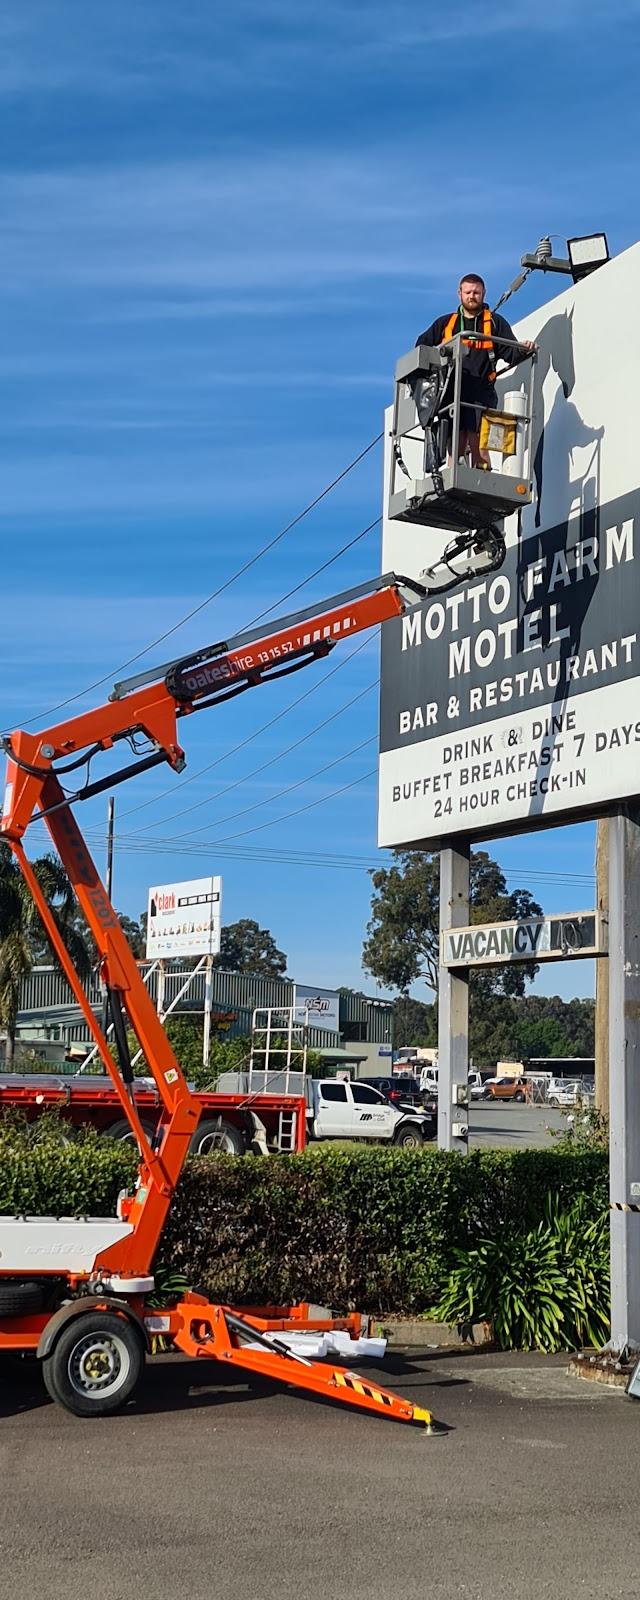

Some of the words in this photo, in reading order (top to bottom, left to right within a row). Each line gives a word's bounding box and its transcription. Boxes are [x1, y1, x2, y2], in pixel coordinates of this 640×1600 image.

[401, 575, 511, 651] MOTTO
[525, 518, 634, 603] FARM
[182, 655, 255, 690] oateshire
[257, 651, 269, 663] 13
[270, 647, 281, 658] 15
[281, 641, 294, 653] 52
[448, 602, 570, 679] MOTEL
[399, 706, 439, 734] BAR
[447, 695, 459, 718] &
[469, 634, 637, 719] RESTAURANT
[443, 734, 493, 764] DRINK
[507, 729, 518, 746] &
[532, 710, 576, 739] DINE
[392, 772, 452, 802] BUFFET
[459, 743, 564, 786] BREAKFAST
[575, 733, 585, 757] 7
[434, 796, 452, 818] 24
[459, 789, 499, 813] HOUR
[506, 768, 587, 799] CHECK-IN
[158, 892, 176, 911] clark
[449, 923, 544, 960] VACANCY
